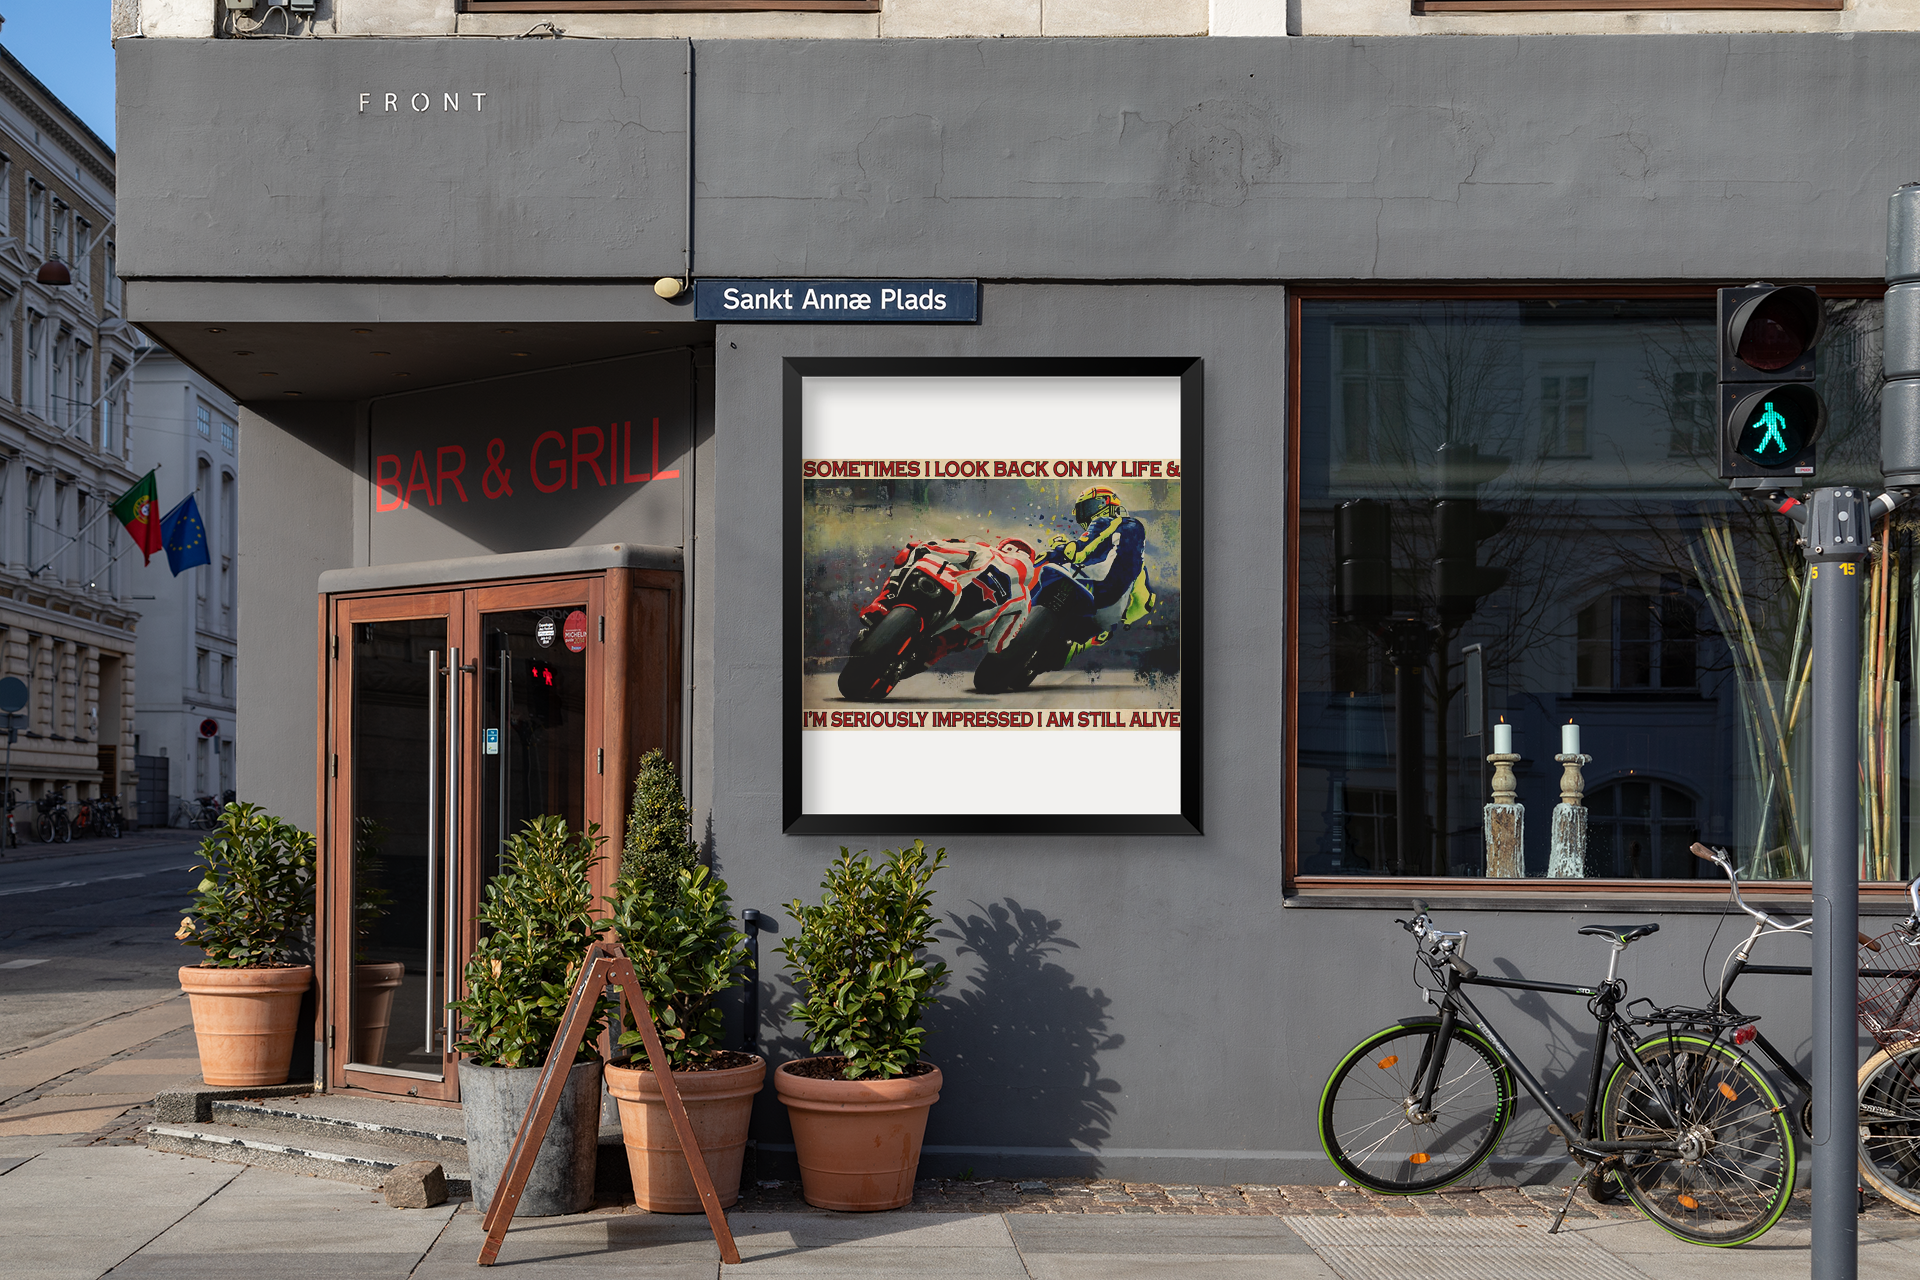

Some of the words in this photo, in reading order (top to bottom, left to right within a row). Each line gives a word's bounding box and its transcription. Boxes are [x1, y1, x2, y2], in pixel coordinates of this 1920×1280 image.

[359, 92, 487, 112] FRONT
[723, 288, 793, 310] Sankt
[802, 288, 872, 310] Annæ
[881, 288, 947, 310] Plads
[376, 445, 468, 512] BAR
[482, 438, 513, 499] &
[530, 417, 680, 493] GRILL
[803, 460, 920, 477] SOMETIMES
[924, 460, 930, 477] I
[934, 460, 990, 477] LOOK
[993, 460, 1049, 477] BACK
[1053, 460, 1082, 477] ON
[1087, 460, 1117, 477] MY
[1121, 460, 1162, 477] LIFE
[1166, 460, 1180, 477] &
[1839, 563, 1855, 575] 15
[803, 711, 827, 728] I'M
[830, 711, 929, 728] SERIOUSLY
[932, 711, 1034, 728] IMPRESSED
[1037, 711, 1042, 728] I
[1046, 711, 1074, 728] AM
[1078, 711, 1126, 728] STILL
[1129, 711, 1180, 728] ALIVE
